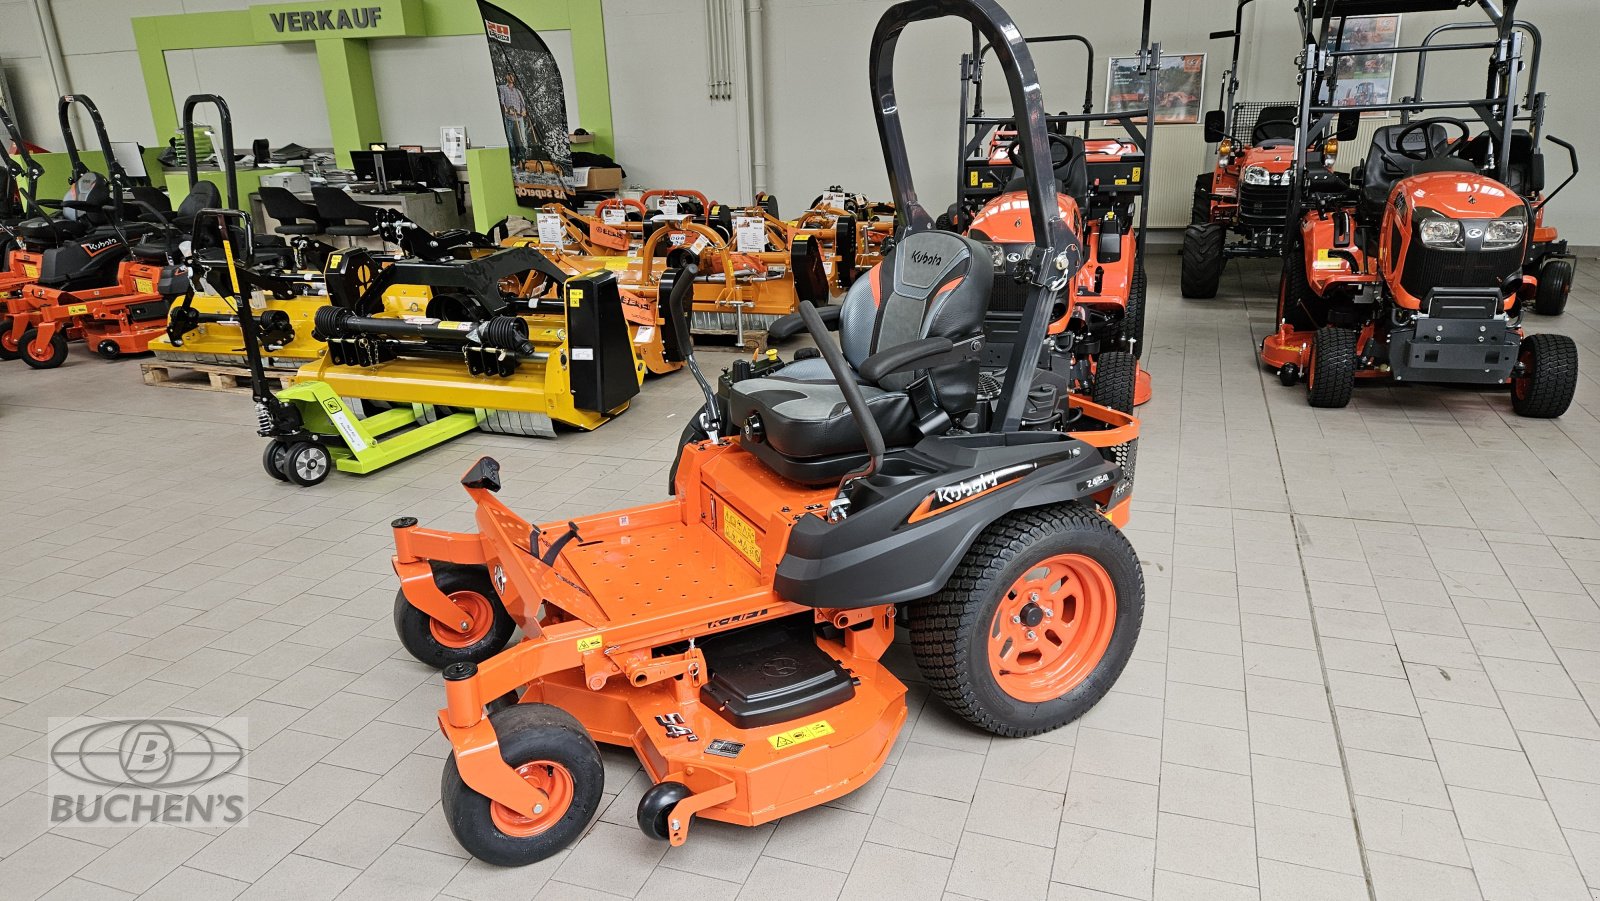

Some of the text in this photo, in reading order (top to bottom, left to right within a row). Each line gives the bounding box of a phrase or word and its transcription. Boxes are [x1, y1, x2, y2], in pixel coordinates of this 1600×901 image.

[269, 7, 382, 33] VERKAUF
[88, 238, 117, 251] Kubota
[911, 250, 942, 266] Kubota
[936, 471, 998, 503] Kubota
